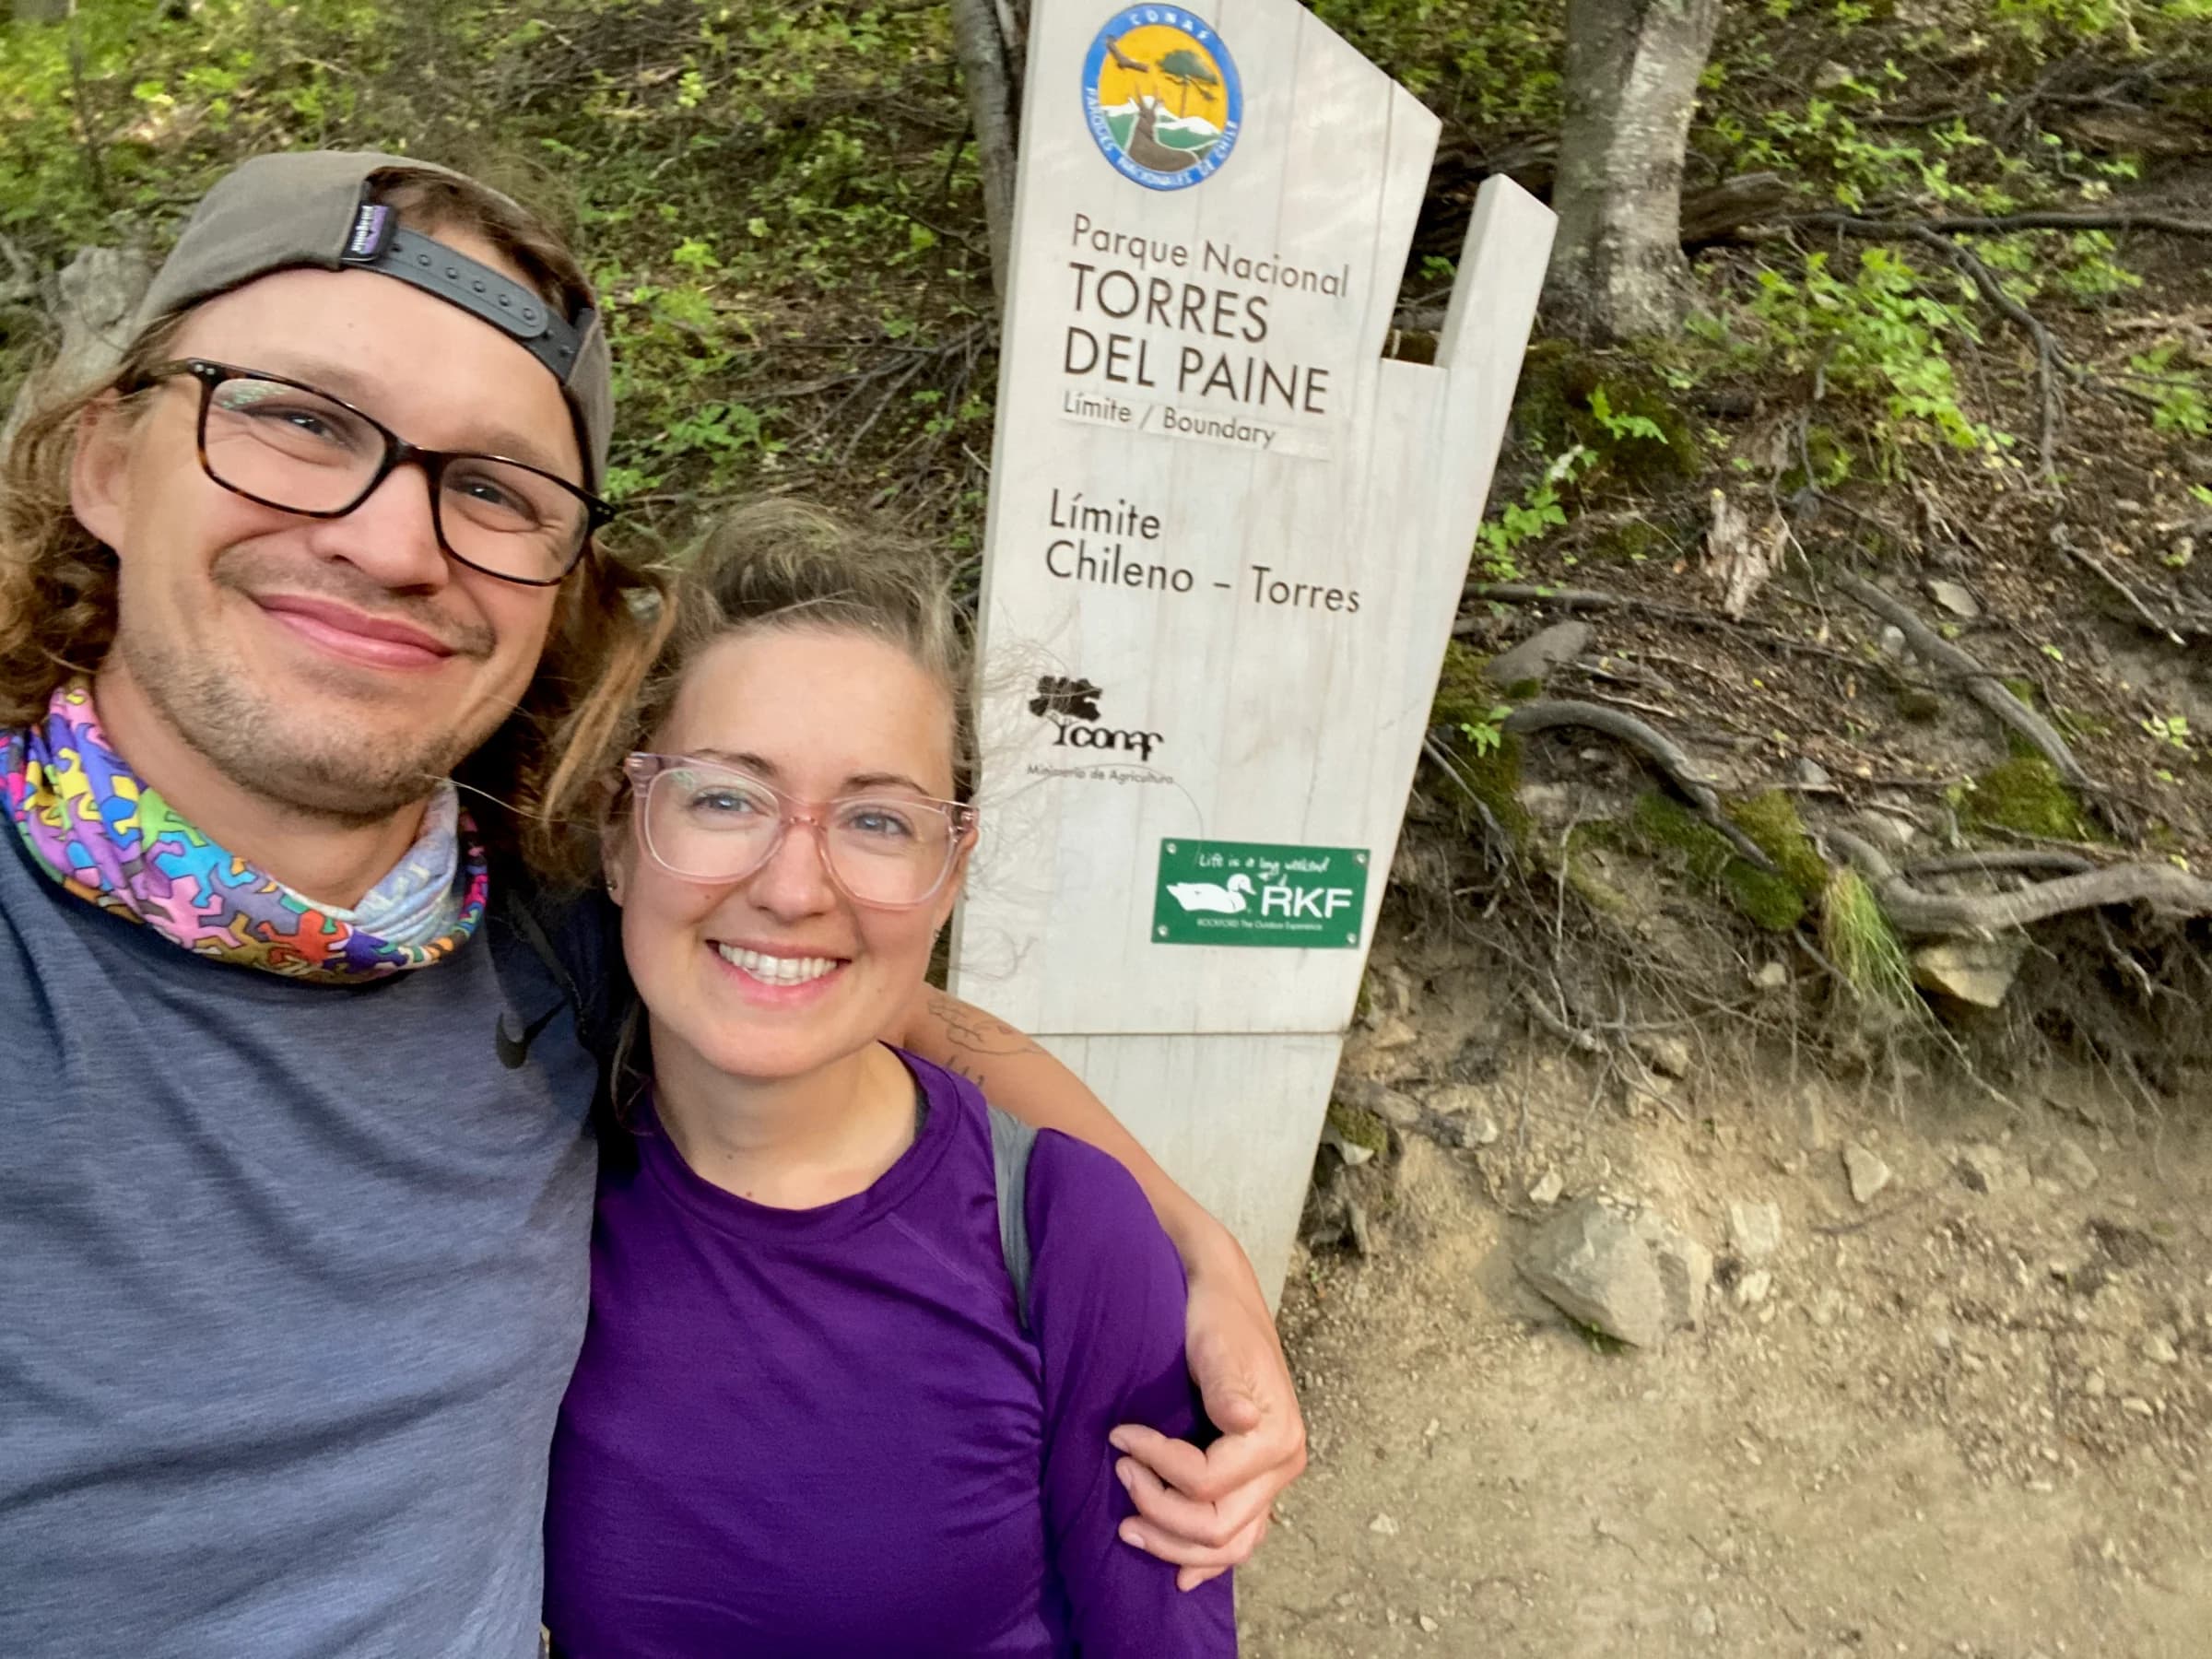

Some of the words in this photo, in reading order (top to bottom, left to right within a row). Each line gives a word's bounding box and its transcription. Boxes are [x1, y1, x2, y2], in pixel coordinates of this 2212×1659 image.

[1129, 9, 1210, 40] CONAF
[1072, 213, 1189, 270] Parque
[1203, 240, 1349, 298] Nacional
[1069, 262, 1268, 343] TORRES
[1065, 326, 1156, 387] DEL
[1178, 347, 1330, 414] PAINE
[1163, 406, 1277, 450] Boundary
[1050, 488, 1160, 539] Límite
[1046, 539, 1194, 593] Chileno
[1252, 565, 1360, 613] Torres
[1261, 886, 1353, 918] RKF
